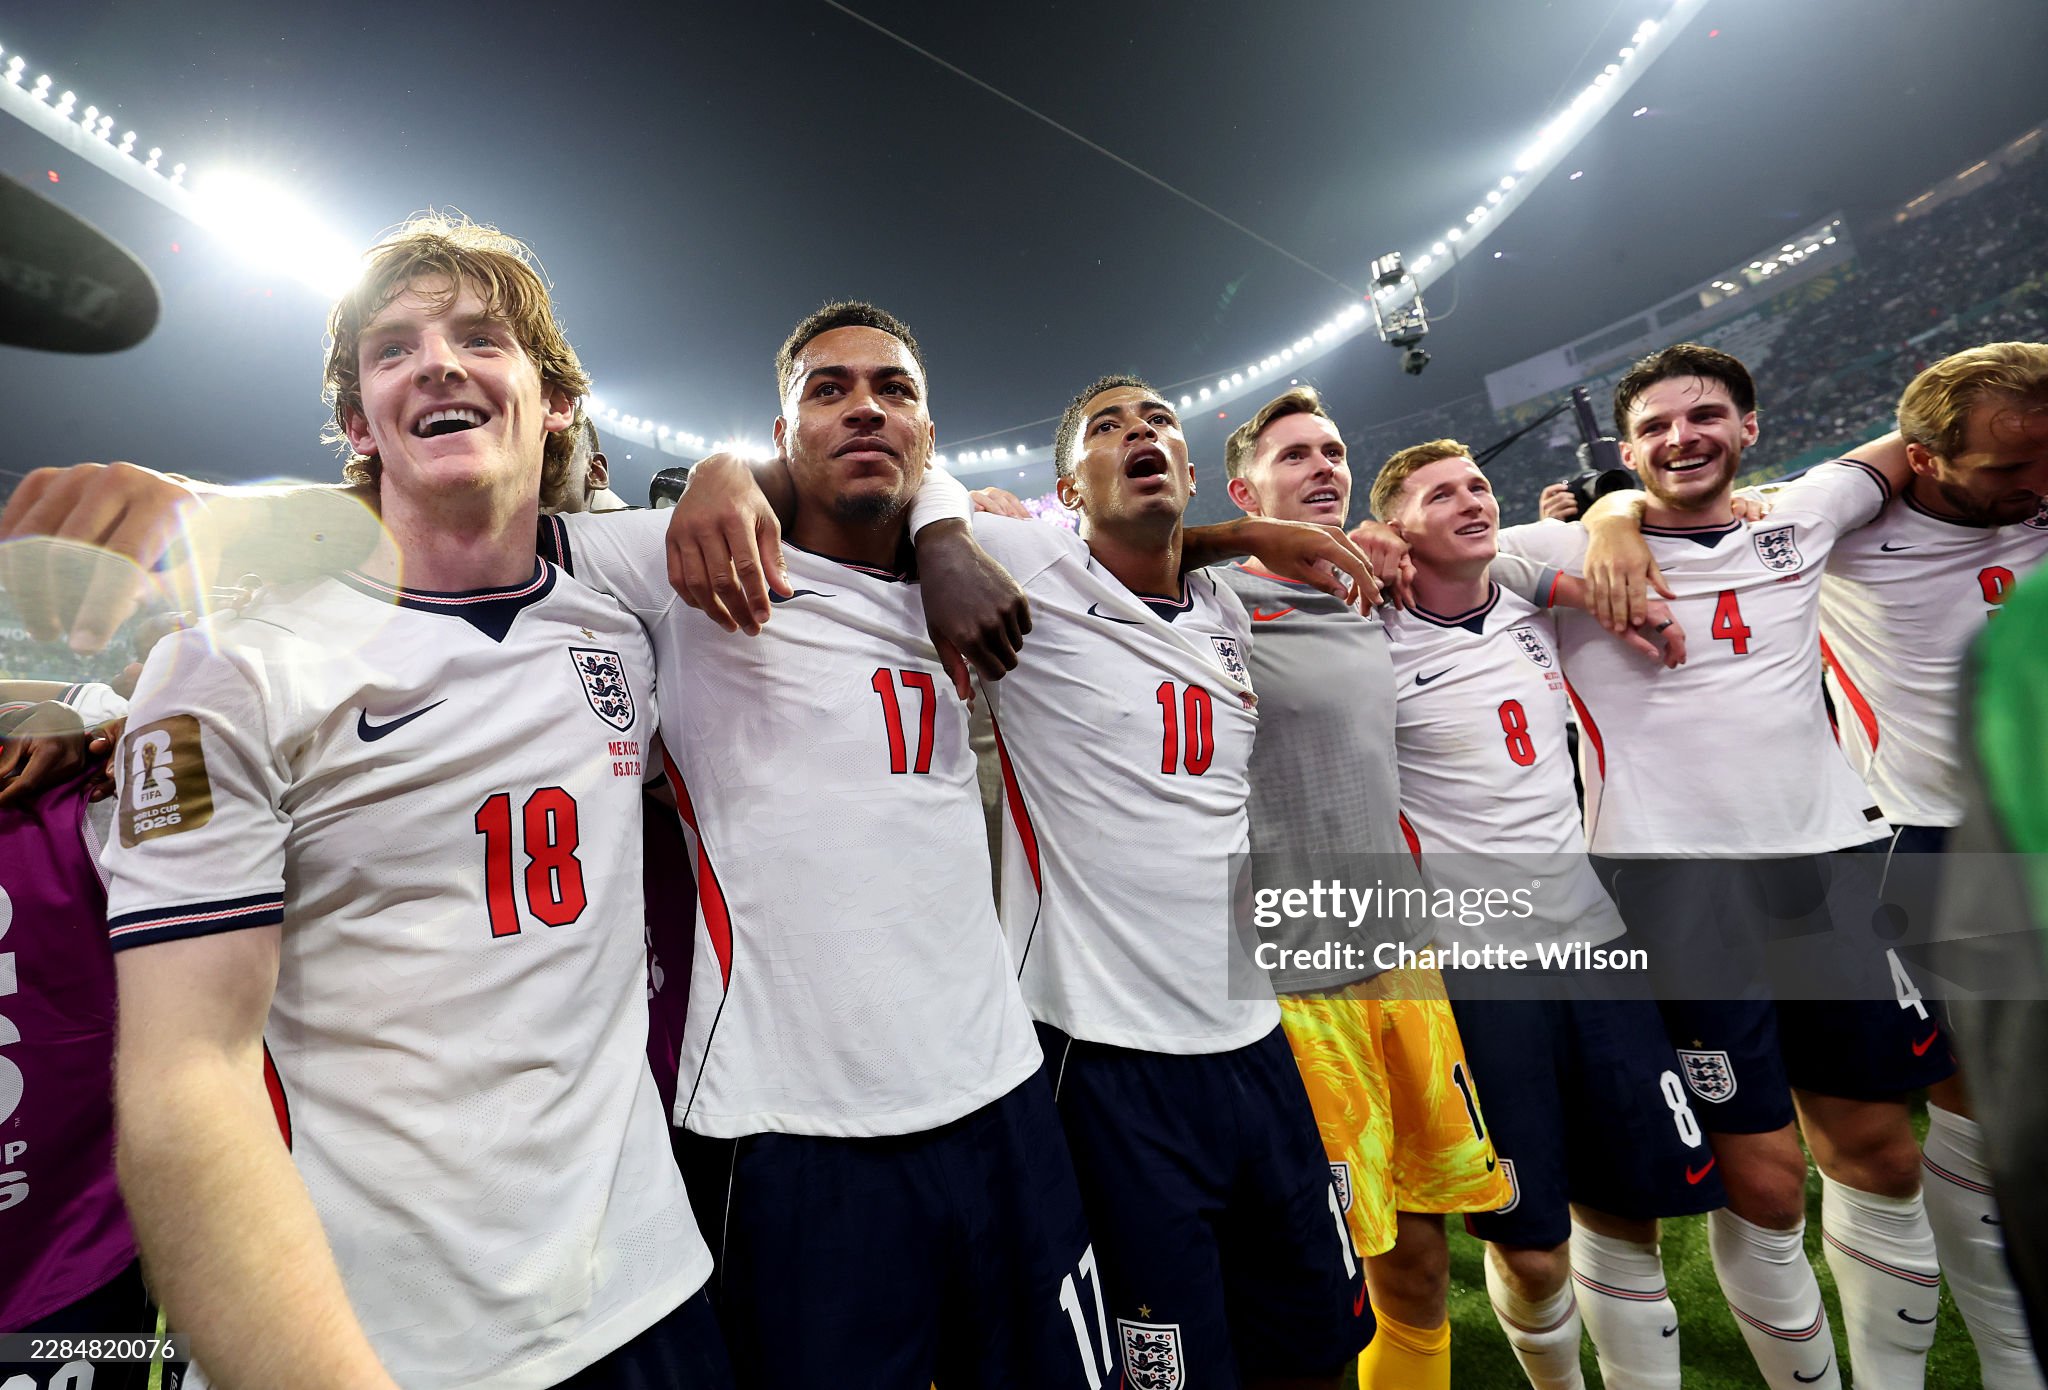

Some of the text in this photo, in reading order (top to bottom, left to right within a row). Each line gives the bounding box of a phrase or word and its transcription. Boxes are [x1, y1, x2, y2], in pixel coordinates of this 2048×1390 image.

[1711, 589, 1752, 654] 4
[608, 741, 640, 756] MEXICO
[870, 667, 937, 775] 17
[1156, 681, 1214, 777] 10
[1497, 699, 1537, 767] 8
[133, 812, 182, 836] 2026
[140, 790, 162, 802] FIFA
[160, 803, 180, 815] CUP
[474, 786, 588, 938] 18
[1886, 948, 1929, 1020] 4
[1660, 1069, 1702, 1149] 8
[1059, 1242, 1114, 1390] 17
